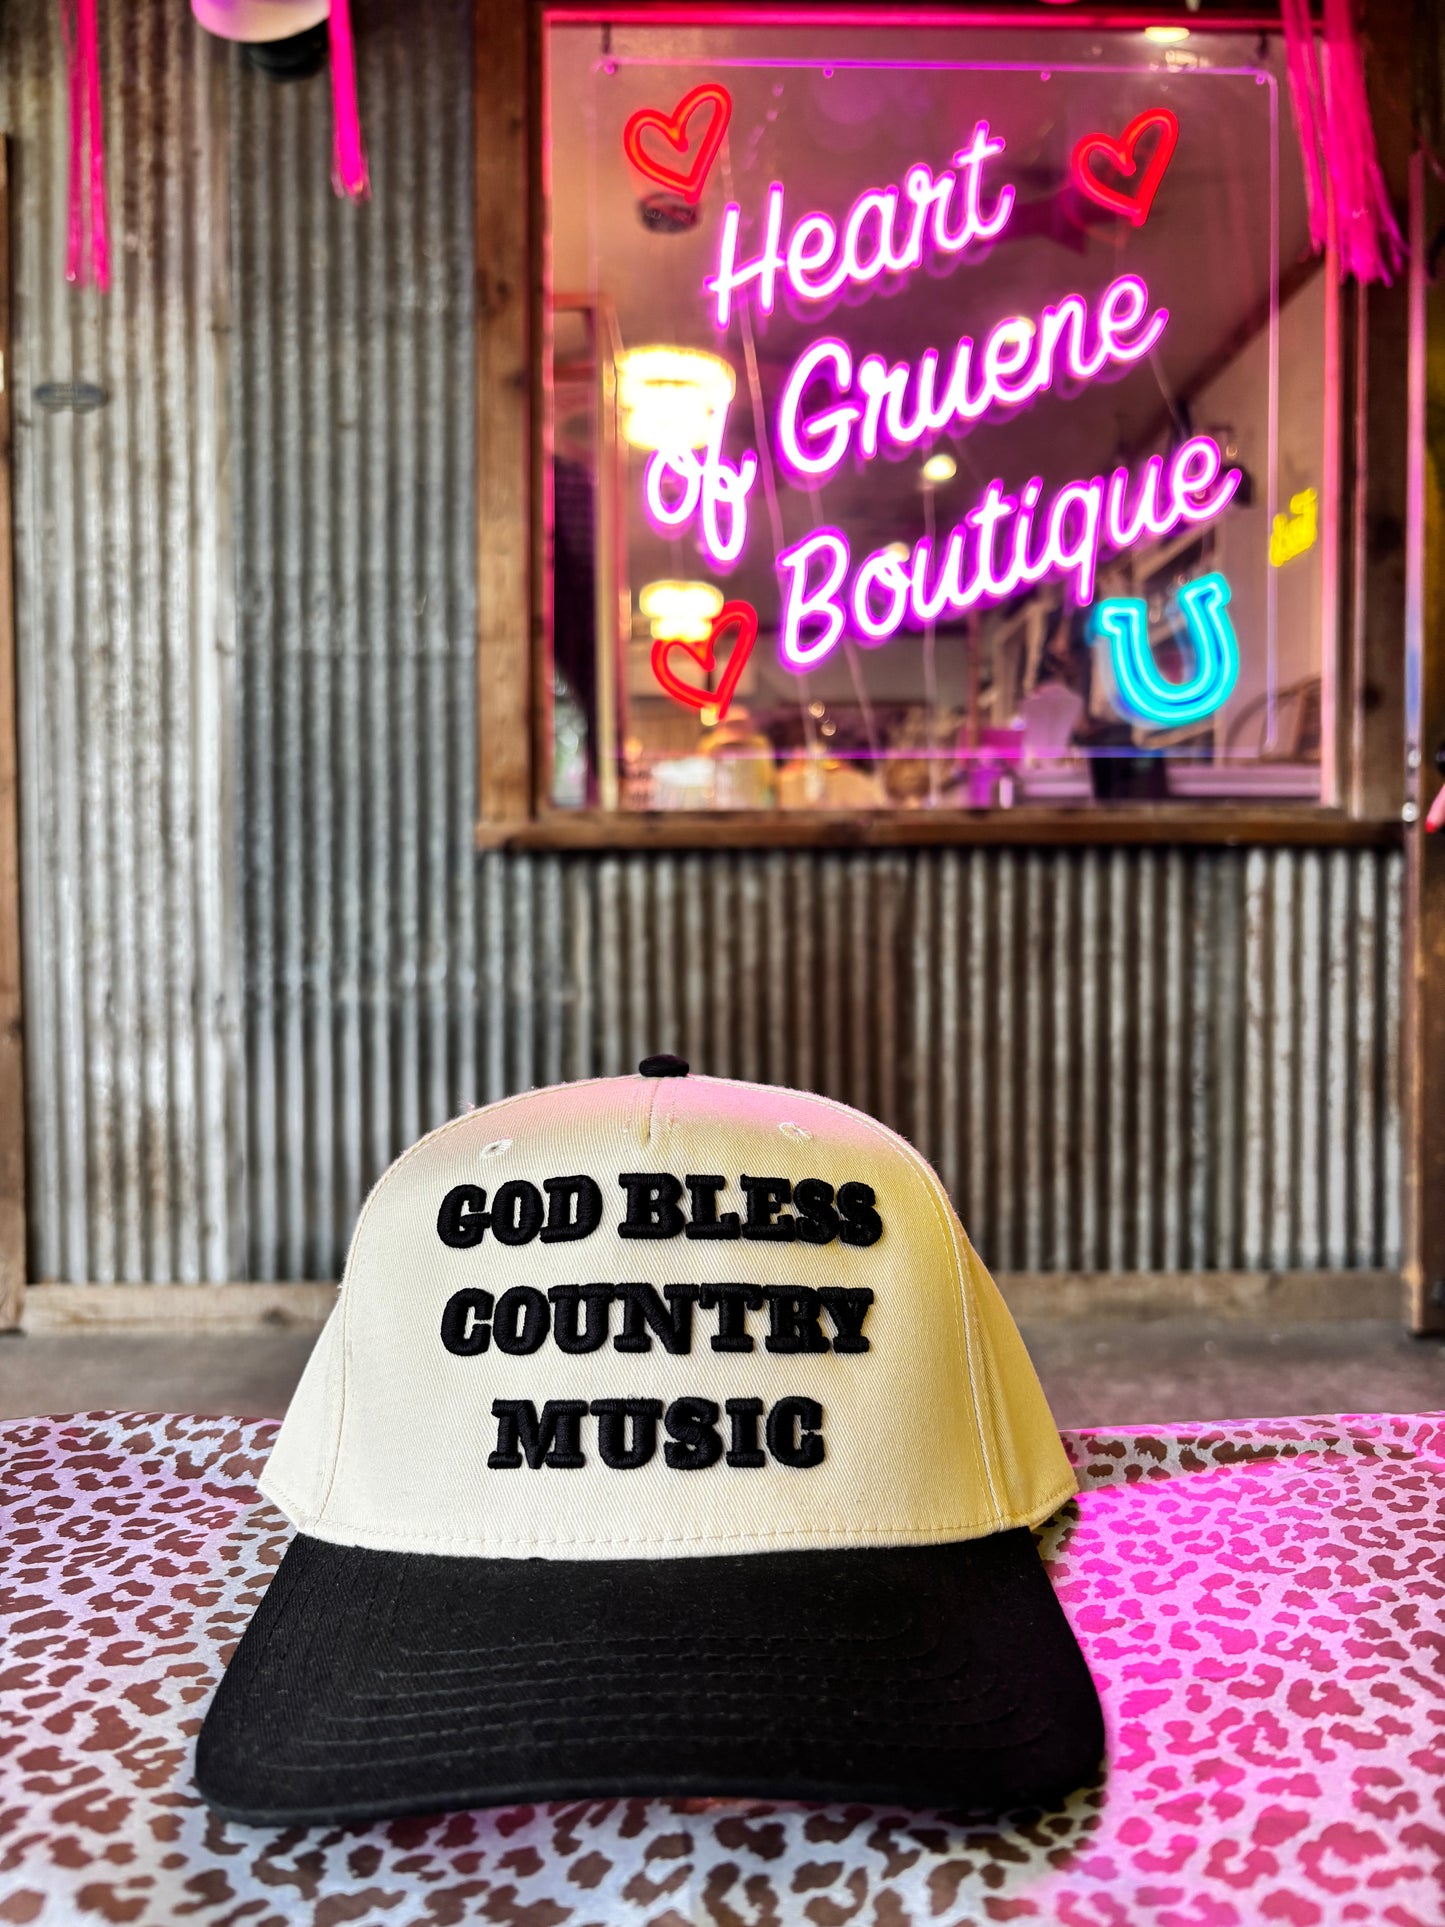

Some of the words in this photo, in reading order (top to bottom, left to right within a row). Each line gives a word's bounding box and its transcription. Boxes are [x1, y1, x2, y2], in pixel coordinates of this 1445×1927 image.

[704, 119, 1016, 329] Heart
[644, 385, 757, 568] of
[777, 274, 1169, 478] Gruene
[777, 434, 1243, 670] Boutique
[437, 1174, 602, 1249] GOD
[618, 1172, 884, 1247] BLESS
[440, 1283, 874, 1357] COUNTRY
[487, 1396, 825, 1470] MUSIC
